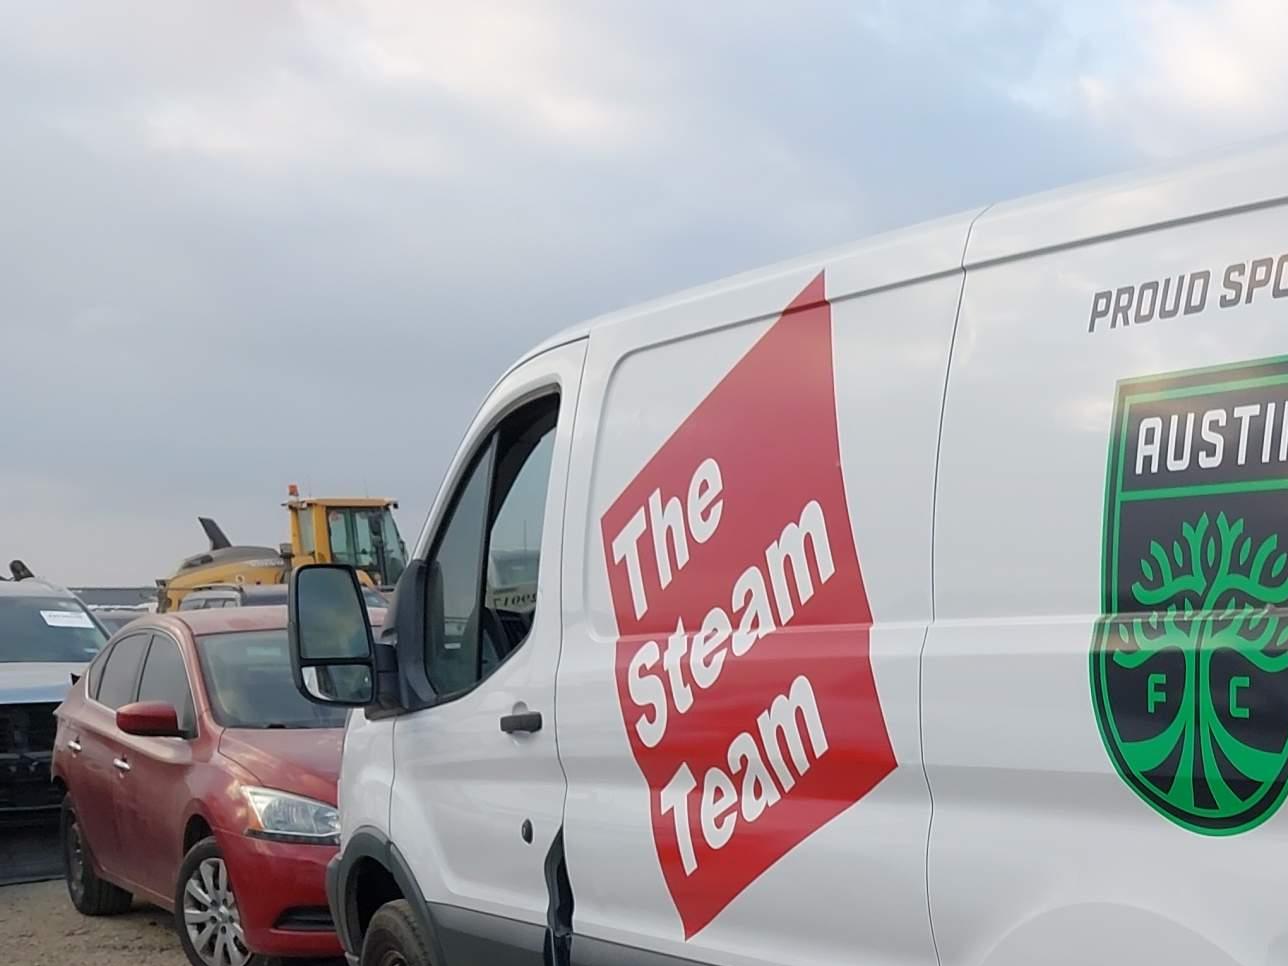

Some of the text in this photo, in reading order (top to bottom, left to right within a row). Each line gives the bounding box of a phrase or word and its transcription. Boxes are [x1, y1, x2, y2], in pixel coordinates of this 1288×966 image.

[1088, 270, 1211, 333] PROUD
[612, 458, 723, 621] The
[627, 500, 835, 748] Steam
[1147, 674, 1250, 719] F C
[661, 675, 828, 876] Team
